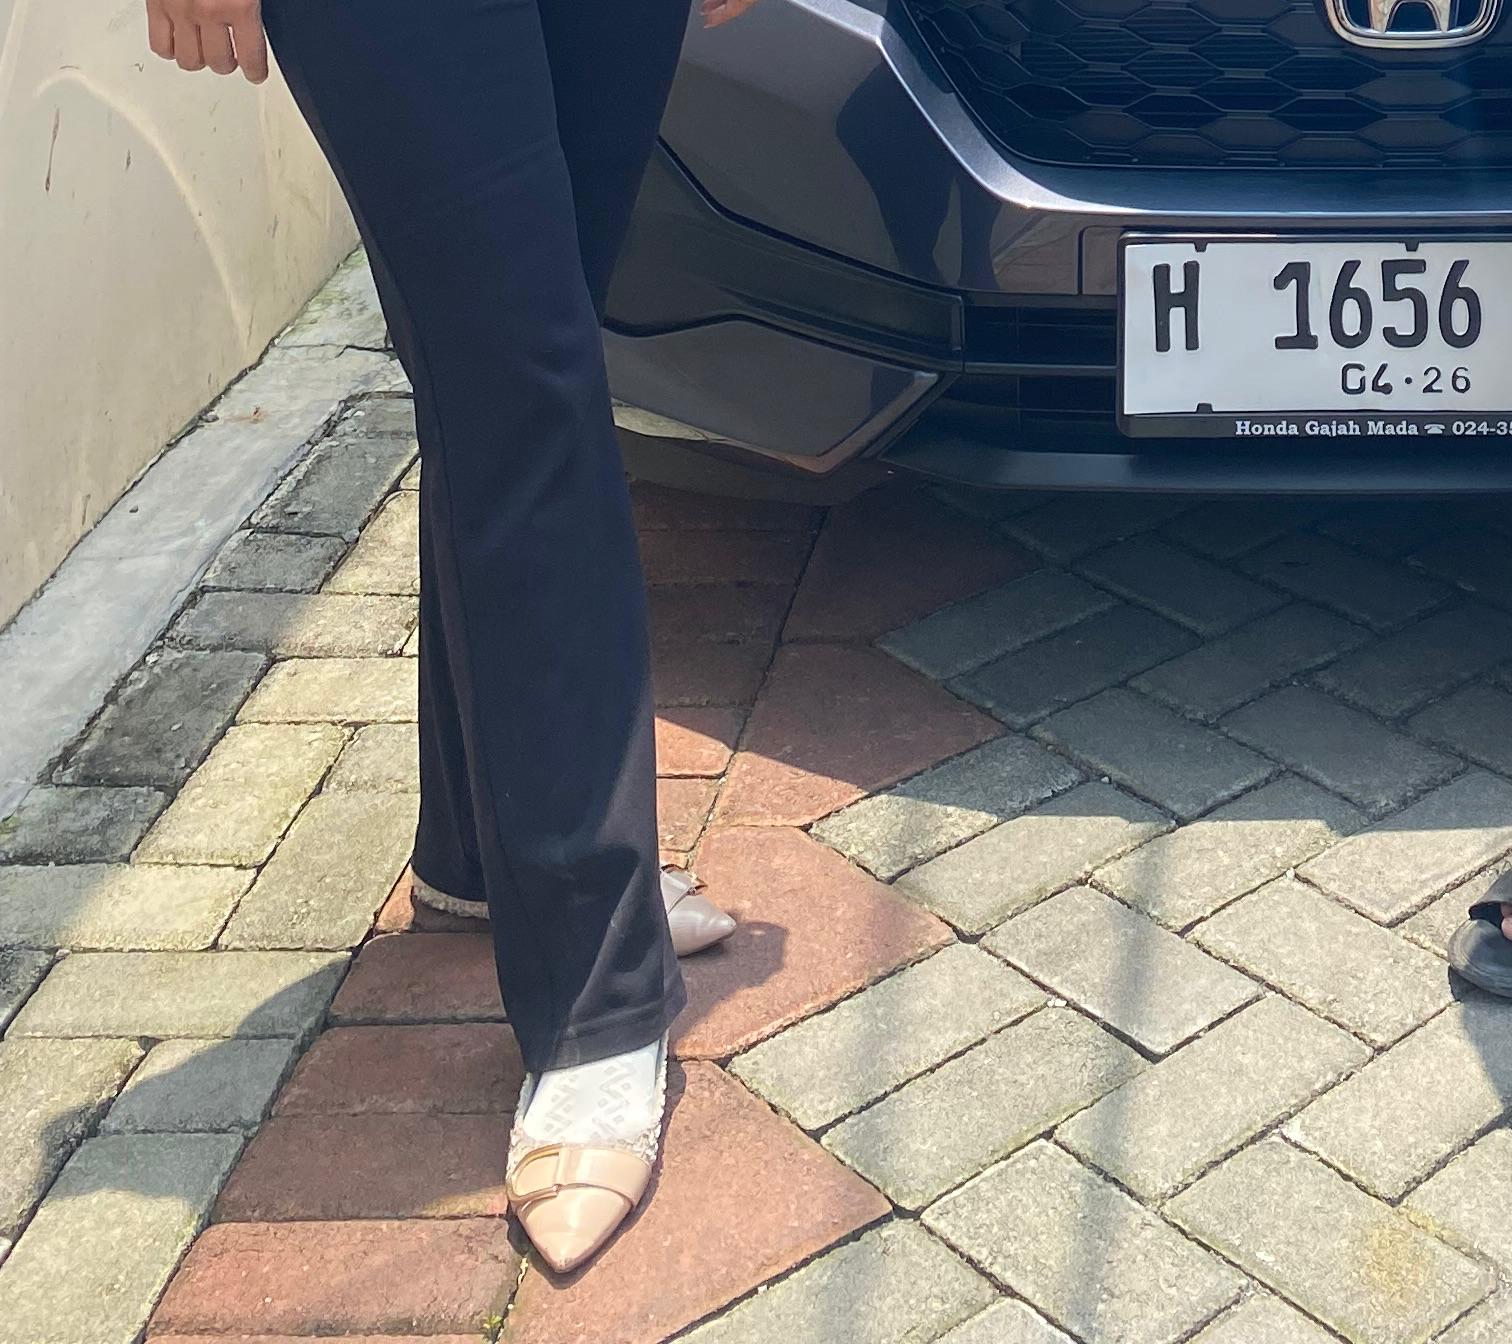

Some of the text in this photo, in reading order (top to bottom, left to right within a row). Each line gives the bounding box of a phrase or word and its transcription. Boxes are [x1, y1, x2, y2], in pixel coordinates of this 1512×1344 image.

[1153, 261, 1199, 352] H
[1274, 259, 1481, 349] 1656
[1235, 420, 1299, 436] Honda
[1305, 420, 1361, 438] Gajah
[1367, 420, 1419, 436] Mada
